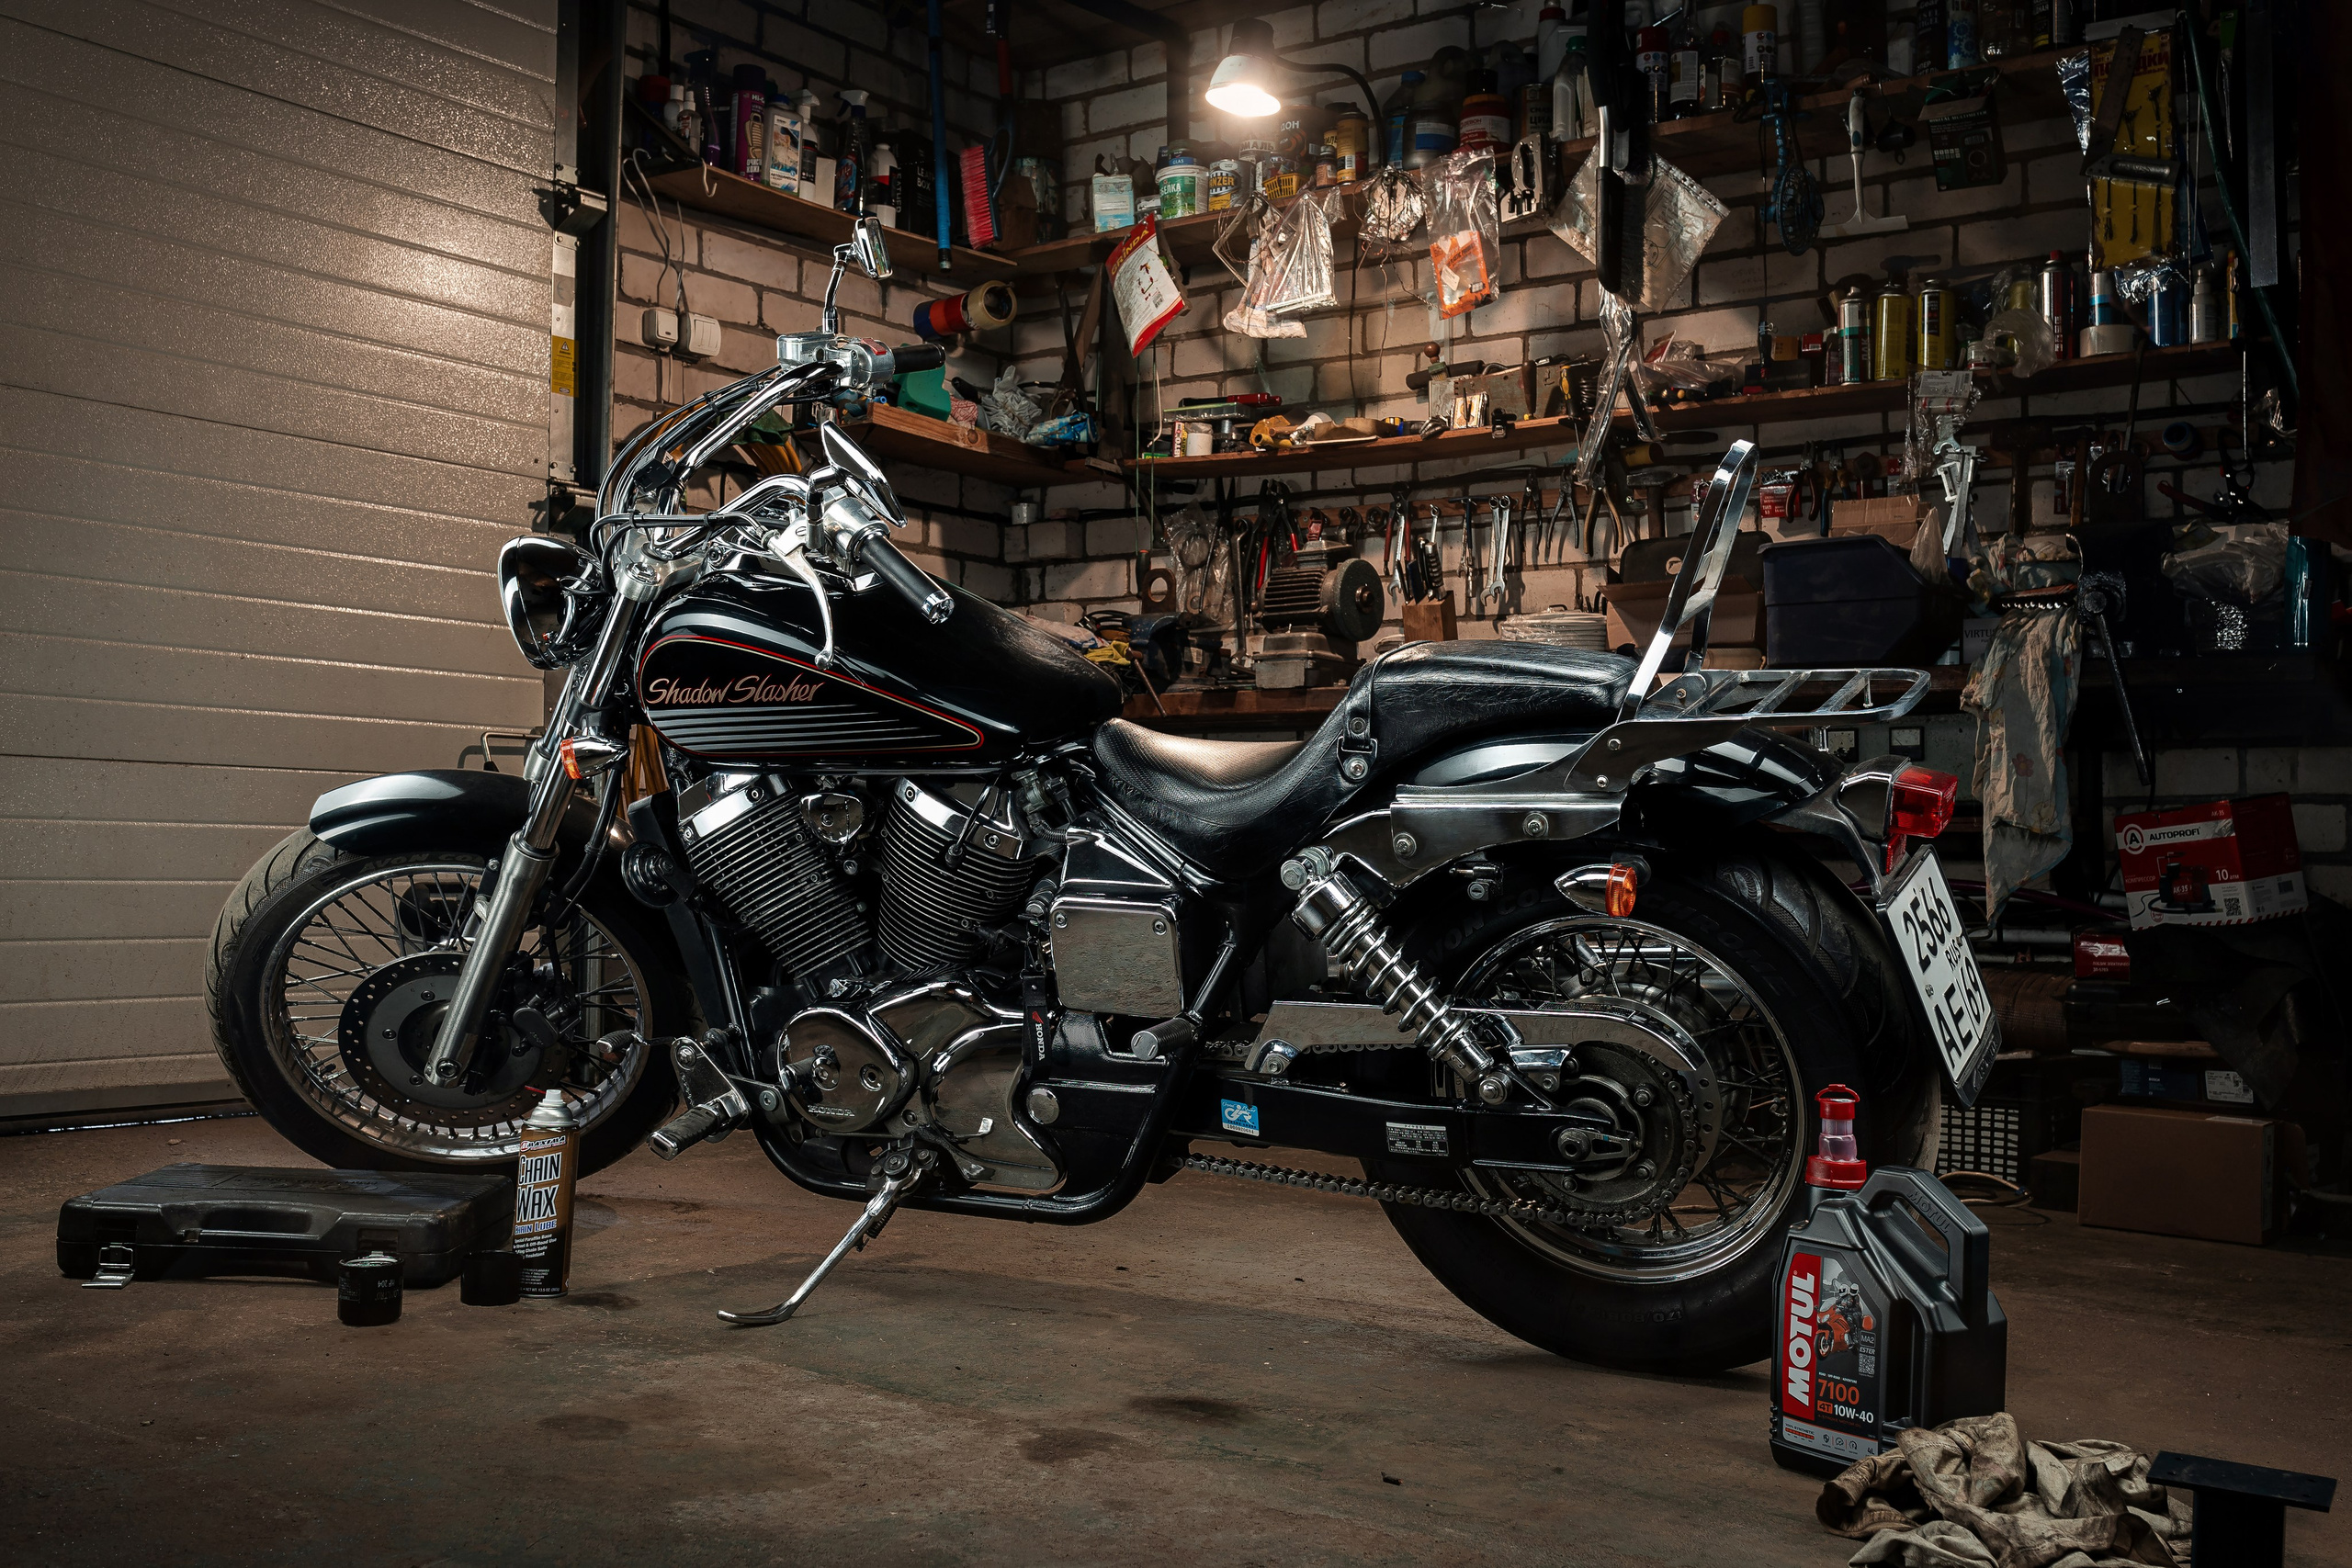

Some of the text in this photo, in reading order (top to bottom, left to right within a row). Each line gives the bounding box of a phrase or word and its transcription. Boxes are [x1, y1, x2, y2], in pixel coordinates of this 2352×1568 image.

[1111, 229, 1150, 276] GRINDA
[645, 672, 825, 705] Shadow Slasher
[2149, 828, 2200, 841] AUTOPROFI
[2125, 875, 2156, 884] КОМПРЕССОР
[2216, 868, 2229, 882] 10
[1902, 876, 1951, 974] 2566
[1945, 942, 1962, 972] RUS
[1960, 956, 1984, 1025] 69
[1035, 1022, 1046, 1061] HONDA
[1934, 982, 1973, 1070] AE
[808, 1105, 855, 1117] HONDA
[518, 1152, 562, 1186] CHAIN
[515, 1184, 560, 1224] WAX
[1905, 1190, 1951, 1235] MOTUL
[535, 1219, 558, 1232] LUBE
[1787, 1271, 1815, 1407] MOTUL
[1859, 1346, 1876, 1355] ESTER
[1860, 1335, 1875, 1345] MA2
[1817, 1378, 1860, 1404] 7100
[1819, 1403, 1874, 1424] 4T 10W-40
